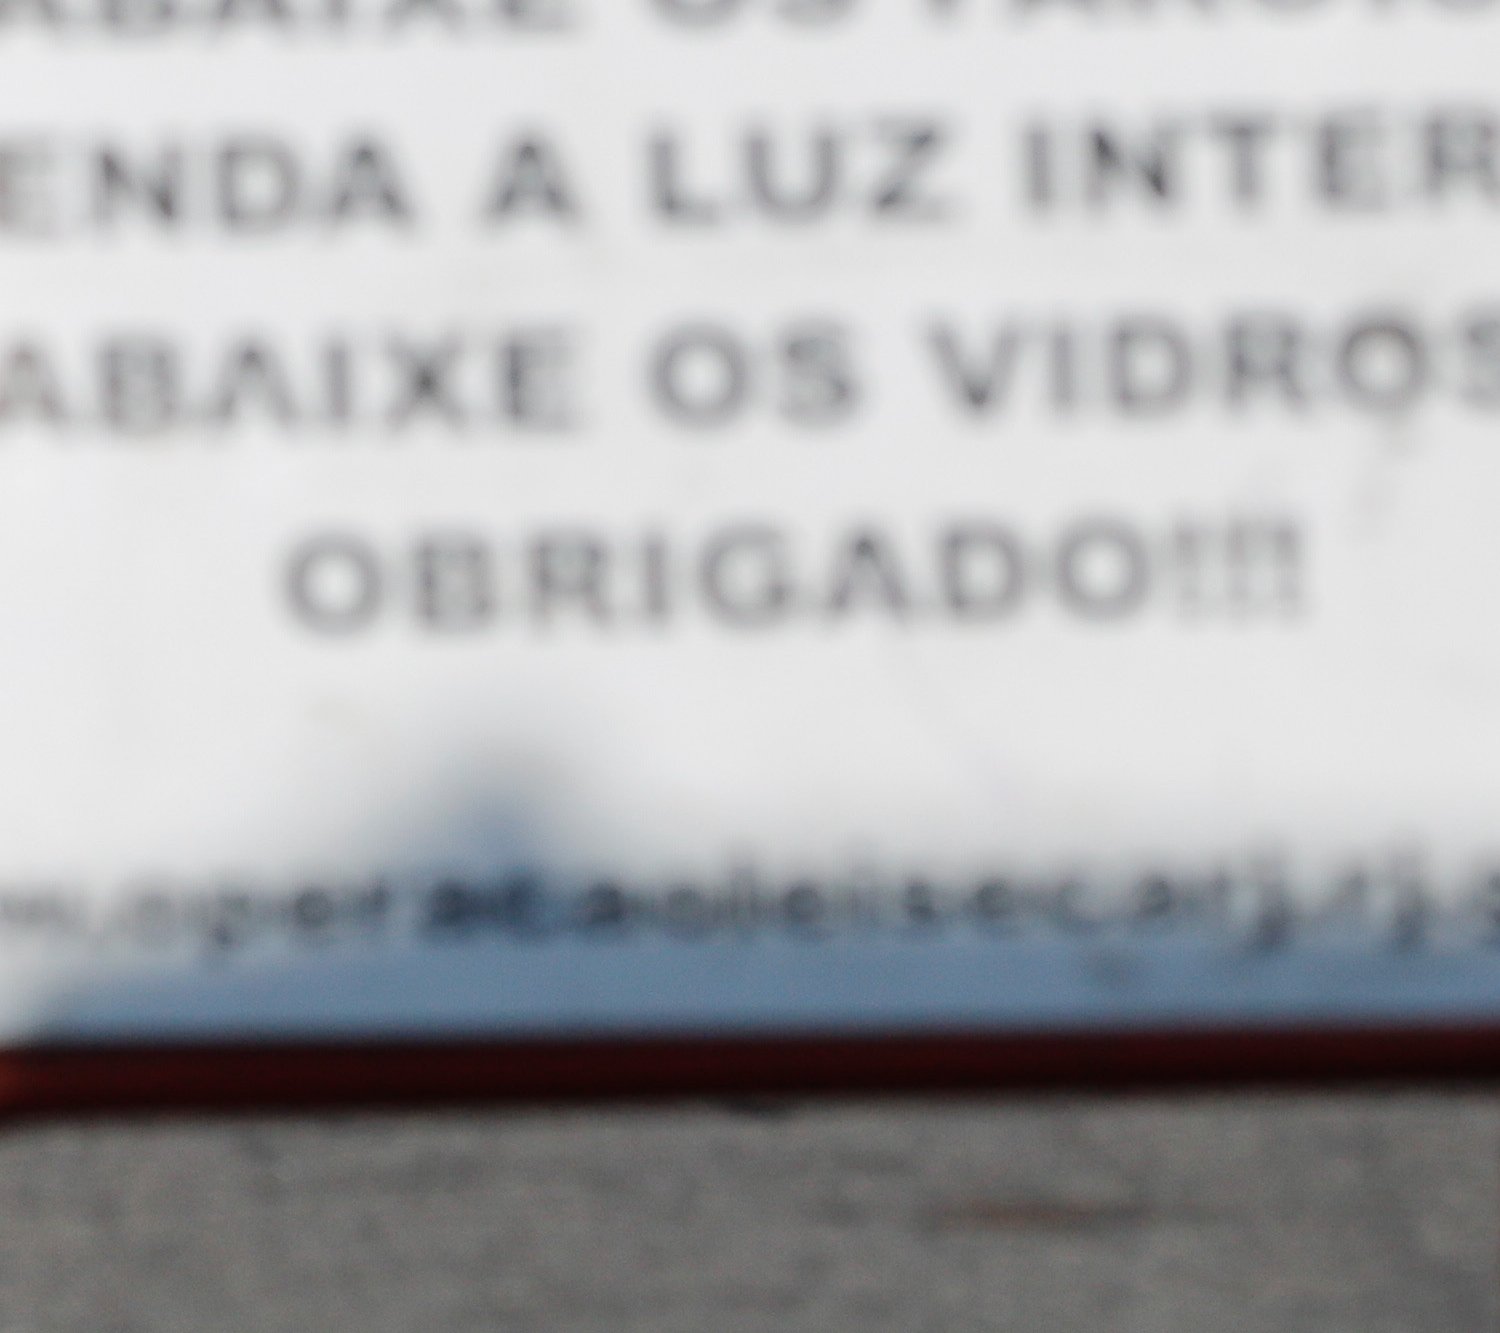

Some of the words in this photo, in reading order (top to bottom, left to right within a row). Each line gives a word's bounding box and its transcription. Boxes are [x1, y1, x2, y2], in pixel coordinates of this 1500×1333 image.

[482, 129, 582, 227] A
[644, 115, 950, 229] LUZ
[644, 317, 866, 431] OS
[280, 515, 1304, 639] OBRIGADO!!!
